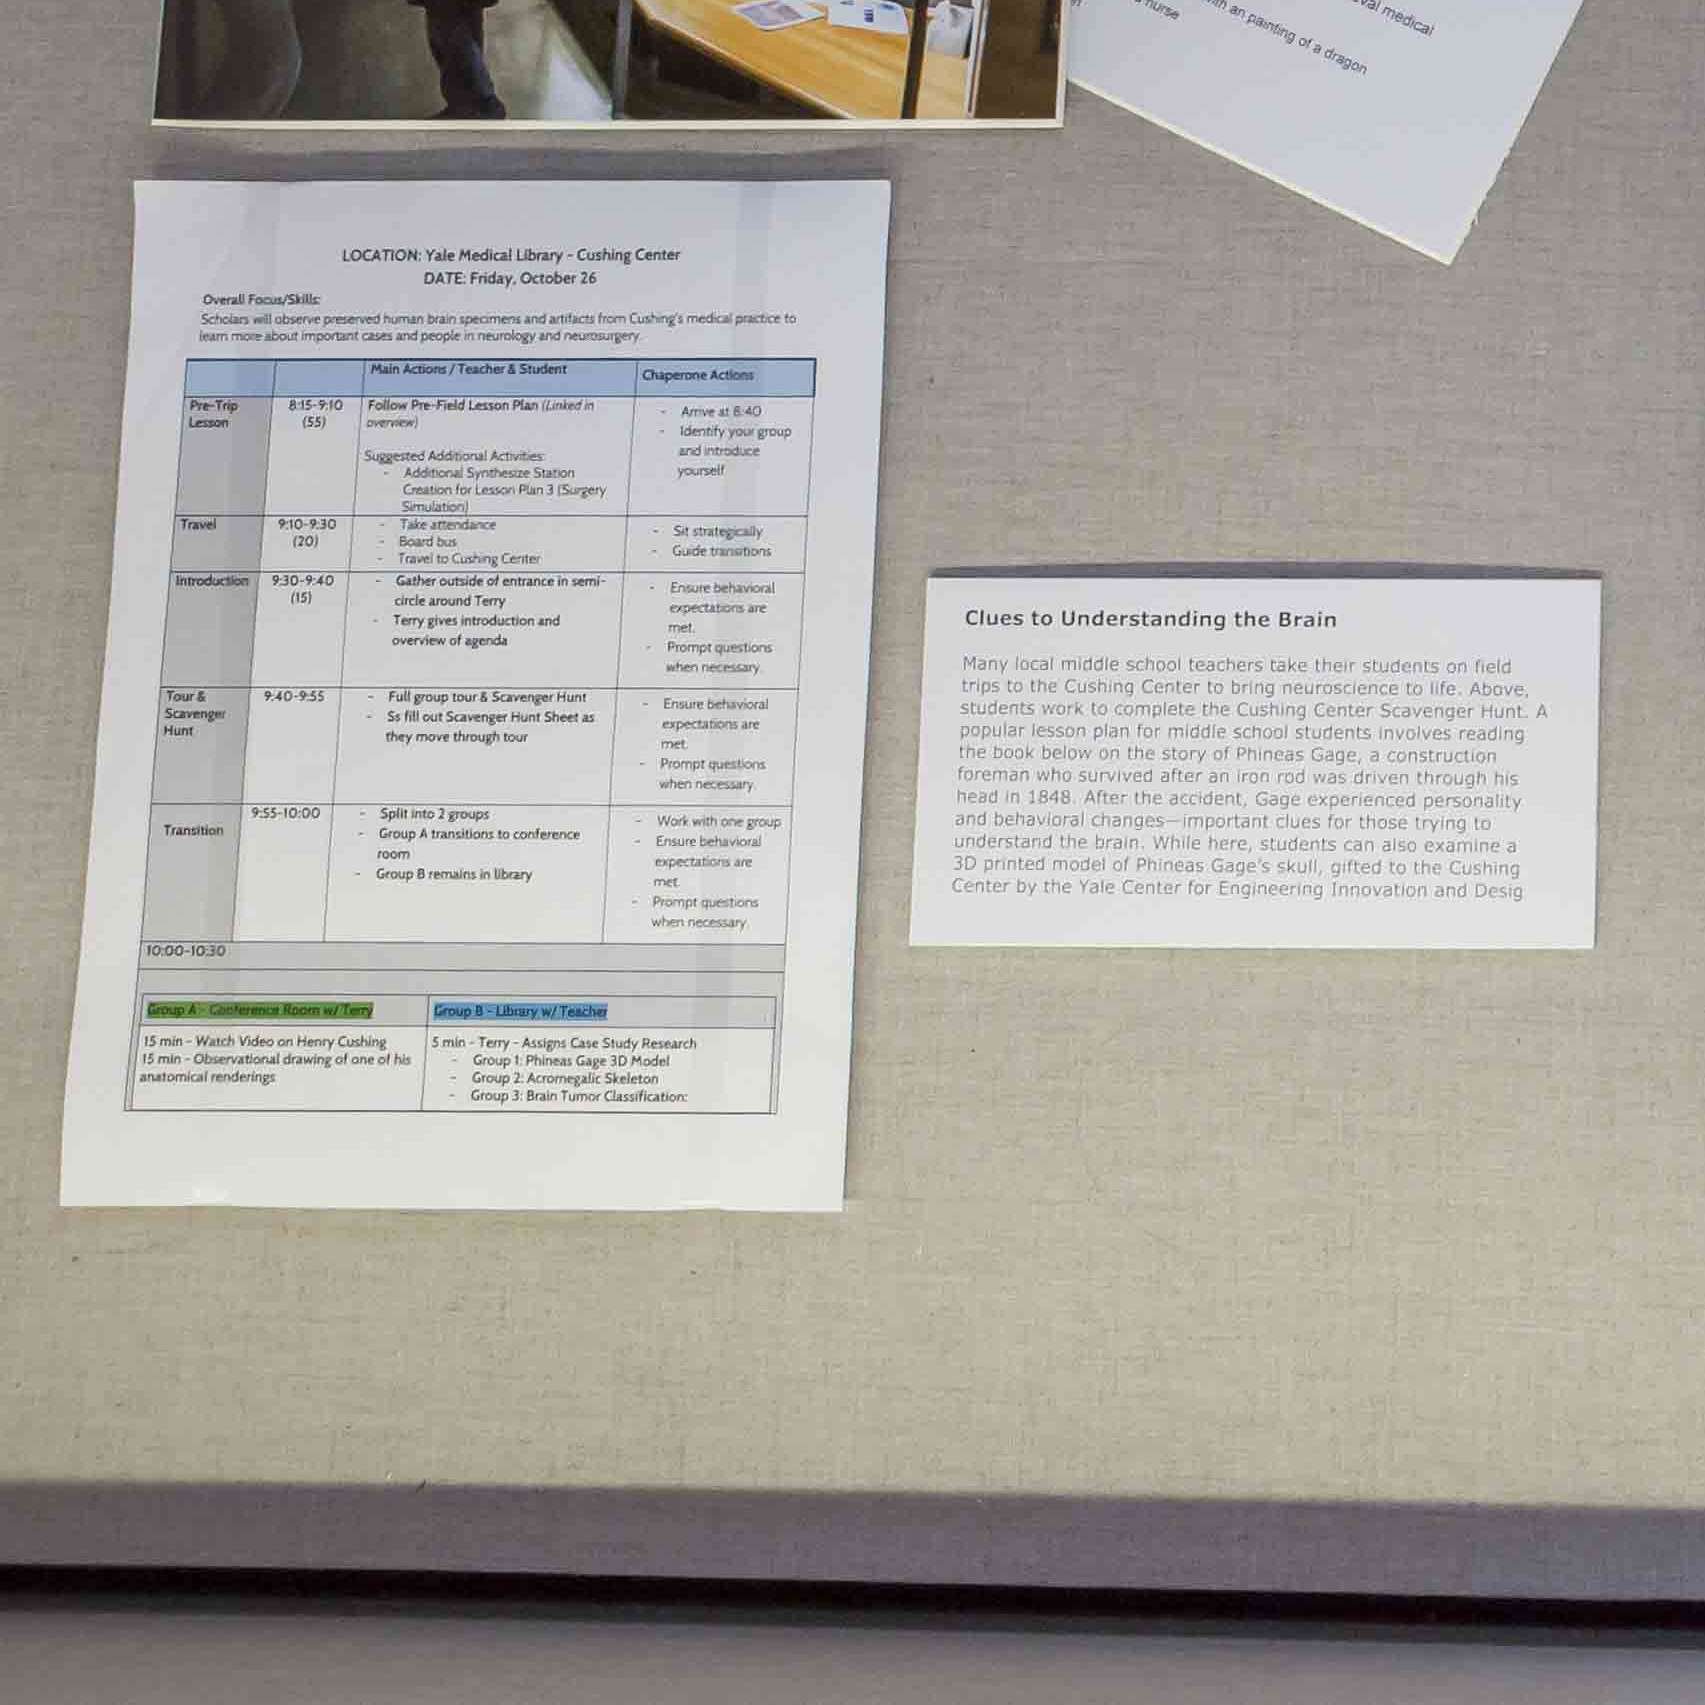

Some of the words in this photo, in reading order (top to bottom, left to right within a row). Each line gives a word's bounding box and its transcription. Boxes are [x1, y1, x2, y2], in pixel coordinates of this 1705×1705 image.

[1228, 5, 1246, 19] an
[1245, 13, 1296, 44] painting
[1298, 37, 1313, 48] of
[1312, 44, 1322, 54] a
[1323, 47, 1367, 75] dragon
[425, 247, 455, 262] Yale
[458, 247, 512, 262] Medical
[516, 247, 563, 265] Library
[576, 247, 632, 265] Cushing
[634, 247, 680, 261] Center
[519, 270, 576, 285] October
[580, 271, 597, 284] 26
[370, 363, 400, 374] Main
[402, 363, 447, 375] Actions
[456, 362, 506, 375] Teacher
[519, 362, 567, 375] Student
[709, 369, 754, 381] Actions
[288, 398, 343, 411] 8:15-9:10
[302, 415, 326, 429] (55)
[278, 518, 336, 530] 9:10-9:30
[398, 551, 433, 564] Travel
[436, 553, 449, 565] to
[451, 552, 499, 568] Cushing
[500, 552, 541, 565] Center
[272, 574, 334, 586] 9:30-9:40
[965, 609, 1024, 626] Clues
[1031, 610, 1053, 626] to
[1061, 609, 1226, 631] Understanding
[1234, 610, 1270, 627] the
[1279, 611, 1336, 627] Brain
[963, 655, 1008, 675] Many
[1015, 655, 1054, 671] local
[1061, 656, 1119, 672] middle
[1125, 656, 1181, 673] school
[1188, 657, 1263, 672] teachers
[1270, 656, 1308, 673] take
[1315, 657, 1356, 673] their
[1362, 658, 1439, 674] students
[1446, 661, 1467, 674] on
[1475, 658, 1511, 674] field
[264, 689, 324, 702] 9:40-9:55
[251, 806, 320, 819] 9:55-10:00
[163, 824, 223, 836] Transition
[147, 944, 226, 957] 10:00-10:30
[471, 1071, 510, 1087] Group
[513, 1071, 524, 1084] 2:
[526, 1071, 601, 1088] Acromegalic
[604, 1071, 659, 1085] Skeleton
